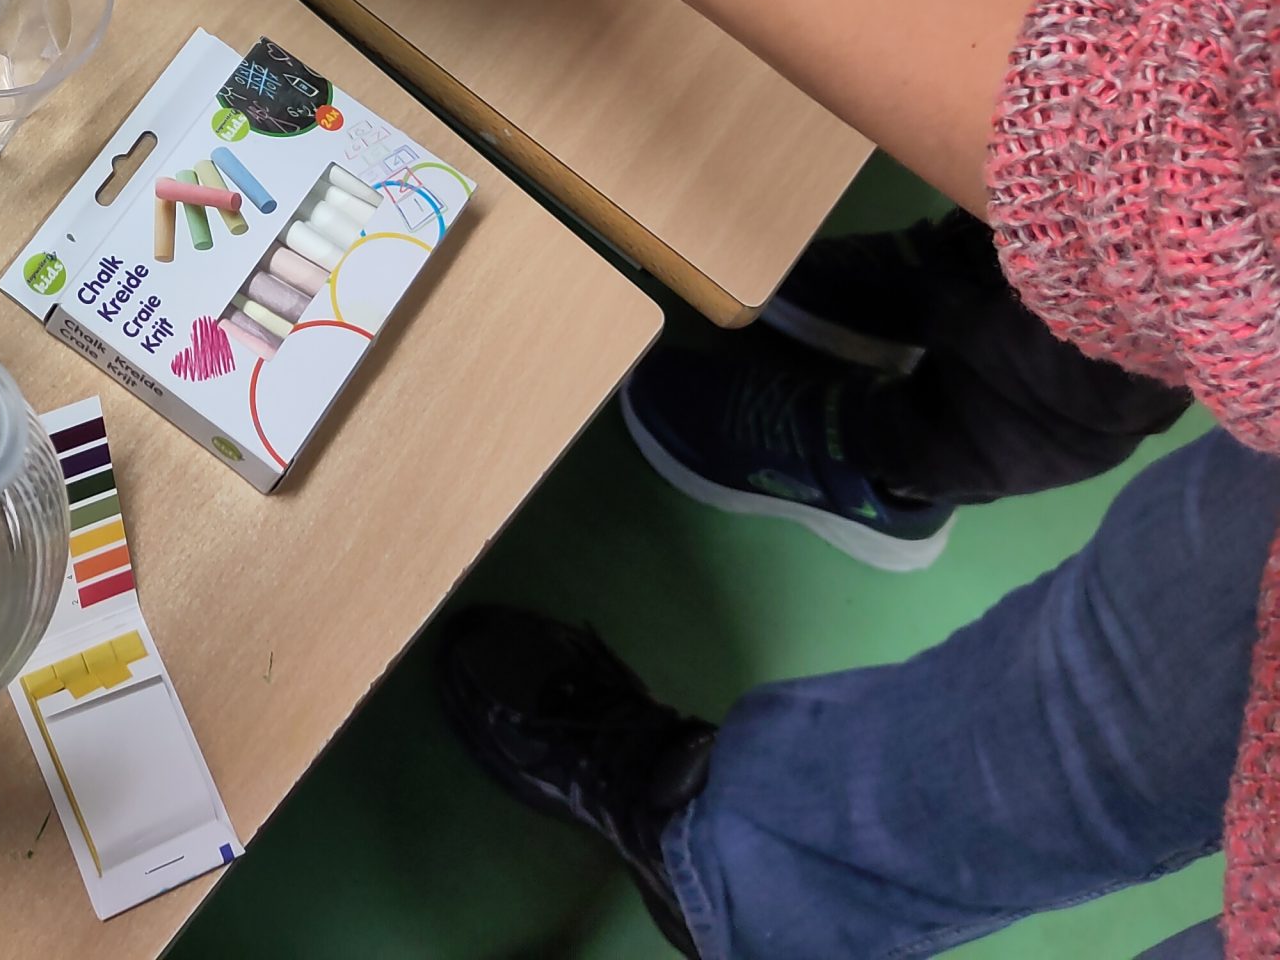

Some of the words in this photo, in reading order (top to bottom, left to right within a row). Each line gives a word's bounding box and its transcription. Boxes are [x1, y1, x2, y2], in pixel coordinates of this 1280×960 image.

[320, 109, 340, 129] 24x
[33, 261, 64, 294] kids
[77, 255, 124, 305] Chalk
[97, 264, 149, 323] Kreide
[122, 295, 162, 338] Craie
[140, 317, 174, 354] Krijt
[59, 328, 99, 360] Craie
[106, 361, 138, 388] Krijt
[64, 319, 107, 354] Chalk
[114, 356, 164, 397] Kreide
